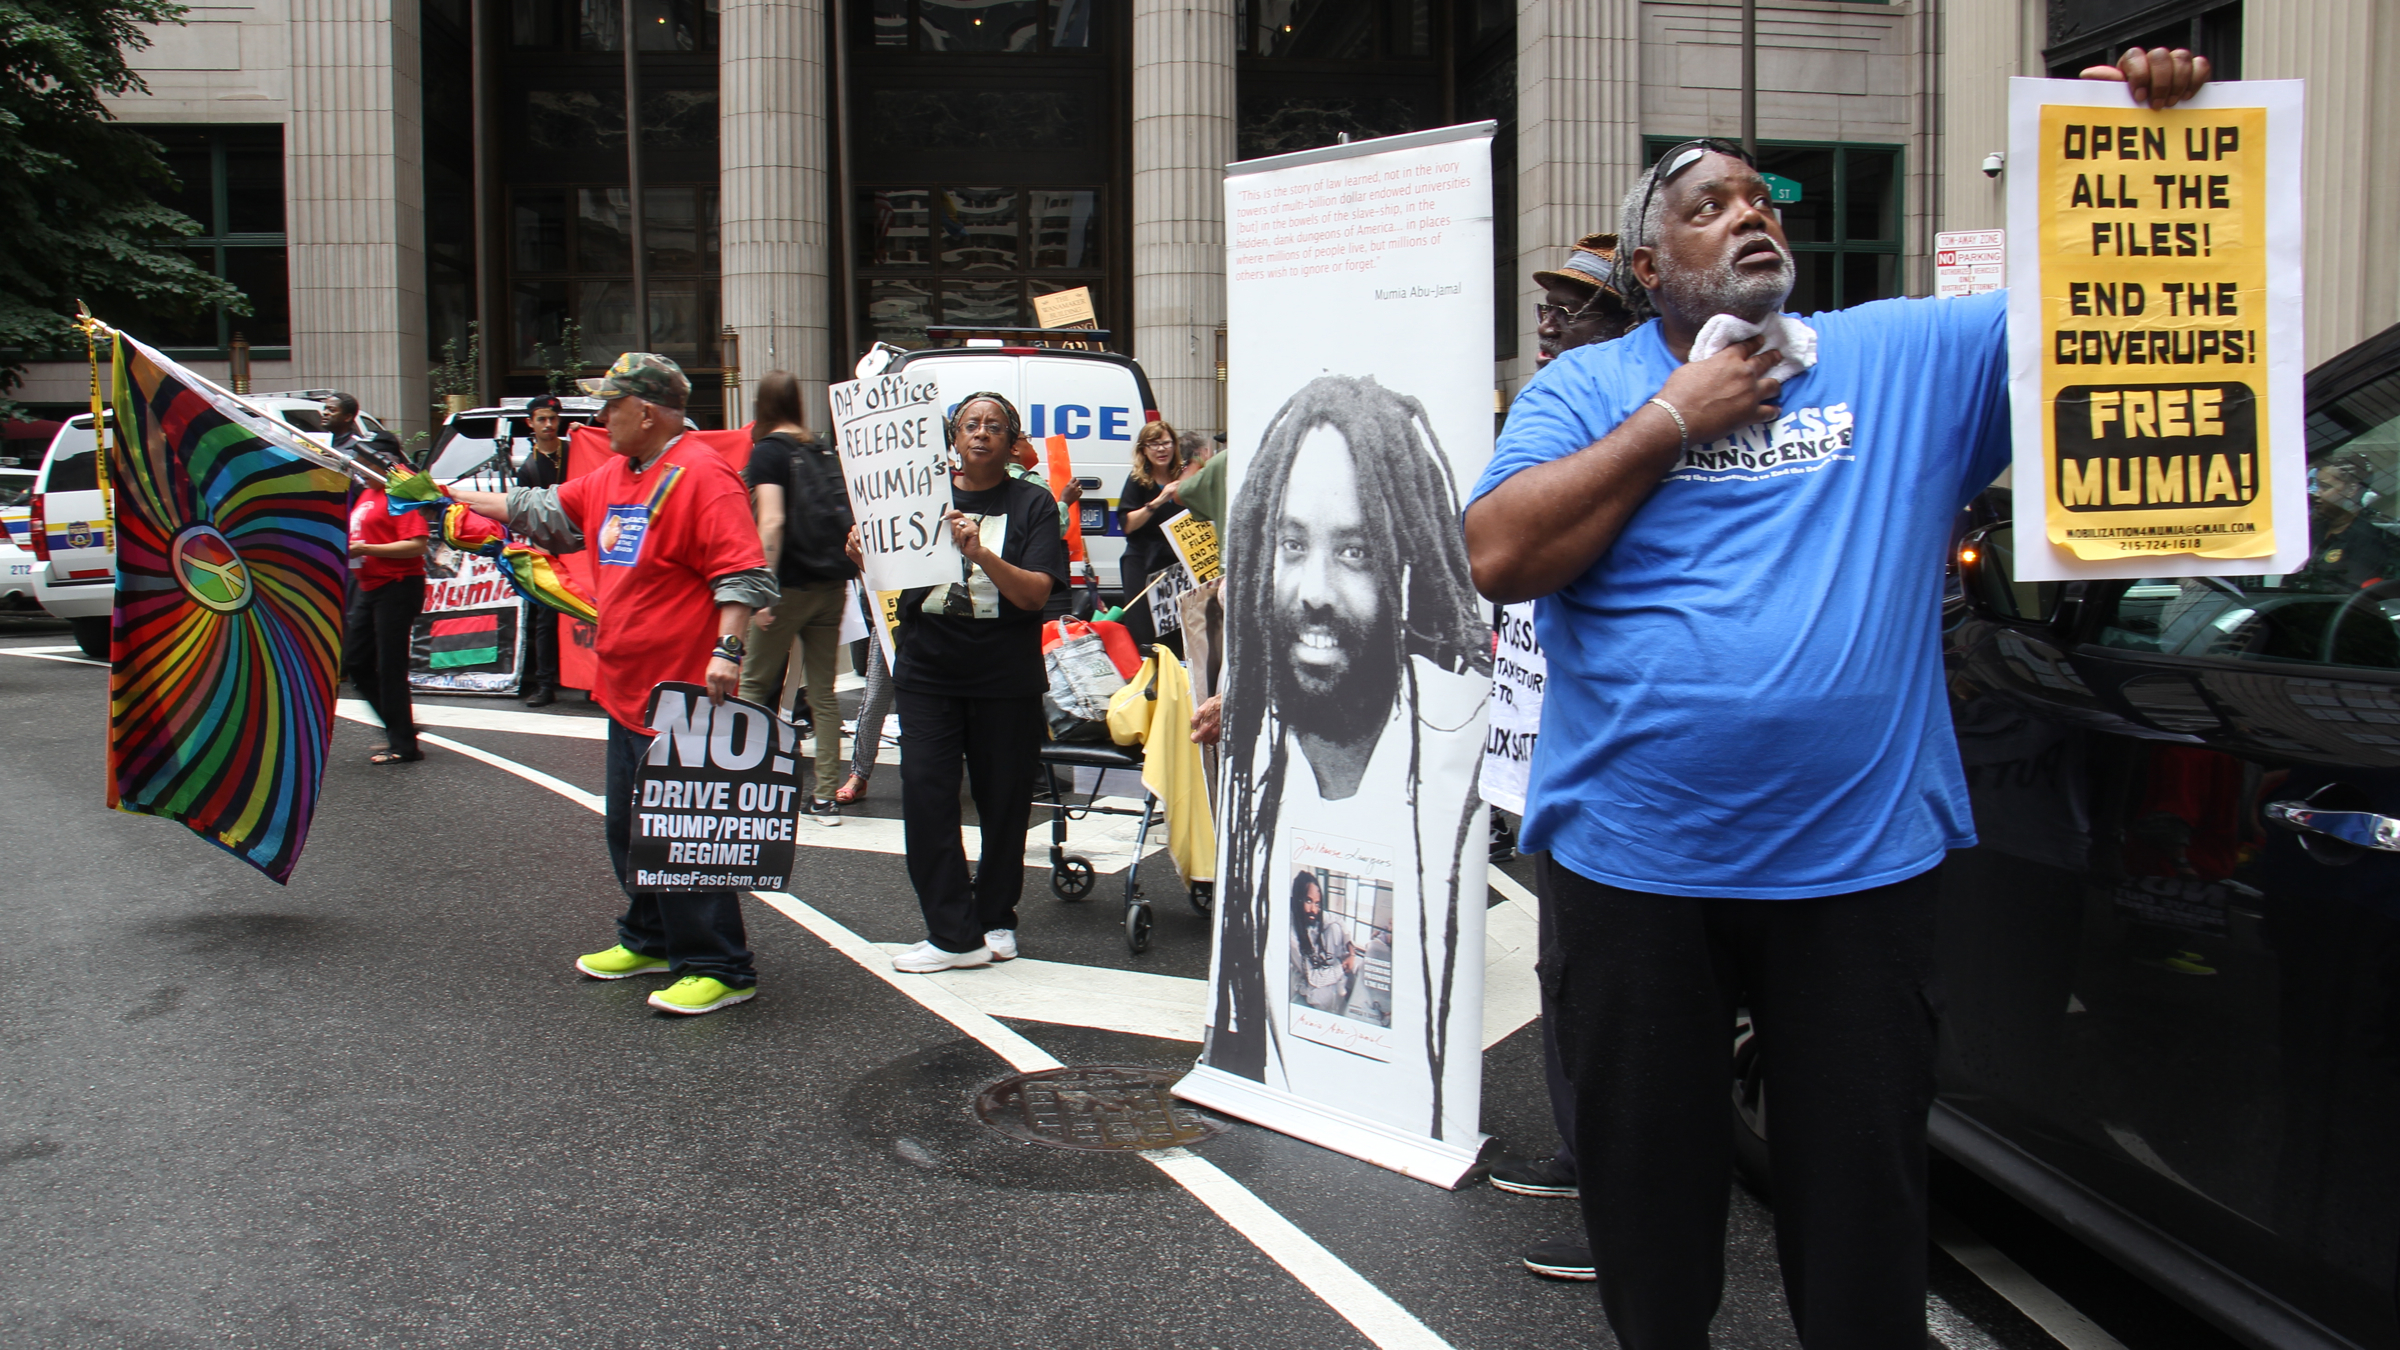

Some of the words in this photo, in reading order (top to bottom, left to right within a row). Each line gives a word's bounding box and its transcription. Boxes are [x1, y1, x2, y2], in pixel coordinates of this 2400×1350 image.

[2065, 124, 2166, 160] OPEN
[2185, 126, 2239, 161] UP
[1237, 204, 1268, 217] towers
[1270, 202, 1280, 214] of
[1340, 191, 1366, 204] dollar
[1369, 183, 1412, 201] endowed
[1415, 177, 1471, 194] universities
[1264, 188, 1271, 198] is
[1274, 186, 1288, 197] the
[1290, 184, 1312, 196] story
[1314, 179, 1324, 191] of
[1326, 178, 1342, 189] law
[1344, 171, 1381, 187] learned,
[1384, 169, 1400, 181] not
[1403, 167, 1412, 178] in
[1415, 164, 1432, 176] the
[1435, 162, 1460, 173] ivory
[1779, 189, 1790, 198] ST
[2071, 173, 2138, 209] ALL
[2154, 174, 2230, 209] THE
[1261, 221, 1270, 231] in
[1273, 218, 1286, 229] the
[1288, 214, 1318, 228] bowels
[1322, 211, 1332, 223] of
[1334, 209, 1349, 222] the
[1406, 201, 1415, 212] in
[1419, 199, 1435, 211] the
[1273, 233, 1295, 246] dank
[1297, 229, 1341, 244] dungeons
[1344, 225, 1354, 237] of
[1406, 219, 1416, 230] in
[1419, 216, 1451, 231] places
[1236, 254, 1264, 265] where
[1266, 250, 1300, 262] millions
[1302, 246, 1313, 259] of
[1314, 244, 1346, 259] people
[1348, 242, 1368, 254] live,
[1370, 240, 1386, 252] but
[1388, 235, 1427, 249] millions
[1431, 231, 1442, 245] of
[2092, 222, 2210, 257] FILES!
[1235, 270, 1265, 281] others
[1267, 266, 1288, 279] wish
[1289, 266, 1298, 276] to
[1301, 265, 1330, 277] ignore
[1332, 263, 1343, 272] or
[1938, 252, 1955, 265] NO
[1958, 252, 2001, 261] PARKING
[1375, 288, 1407, 301] Mumia
[1410, 282, 1462, 299] Abu-Jamal
[2070, 282, 2145, 317] END
[2162, 282, 2237, 317] THE
[2056, 330, 2255, 365] COVERUPS!
[1031, 404, 1131, 441] ICE
[2090, 388, 2224, 439] FREE
[845, 416, 929, 460] RELEASE
[1685, 427, 1853, 470] INNOCENCE
[2062, 453, 2252, 507] MUMIA!
[1082, 509, 1099, 522] 80F
[2066, 523, 2256, 539] MOBILIZATION4MUMIA@GMAIL.COM
[1181, 530, 1195, 542] ALL
[1188, 530, 1214, 549] FILES!
[2120, 538, 2201, 551] 215-724-1618
[1190, 548, 1207, 562] END
[647, 690, 796, 775] NO!
[1487, 724, 1511, 758] LIX
[641, 779, 730, 810] DRIVE
[738, 782, 797, 813] OUT
[639, 813, 793, 842] TRUMP/PENCE
[667, 842, 760, 866] REGIME!
[637, 869, 783, 890] RefuseFascism.org
